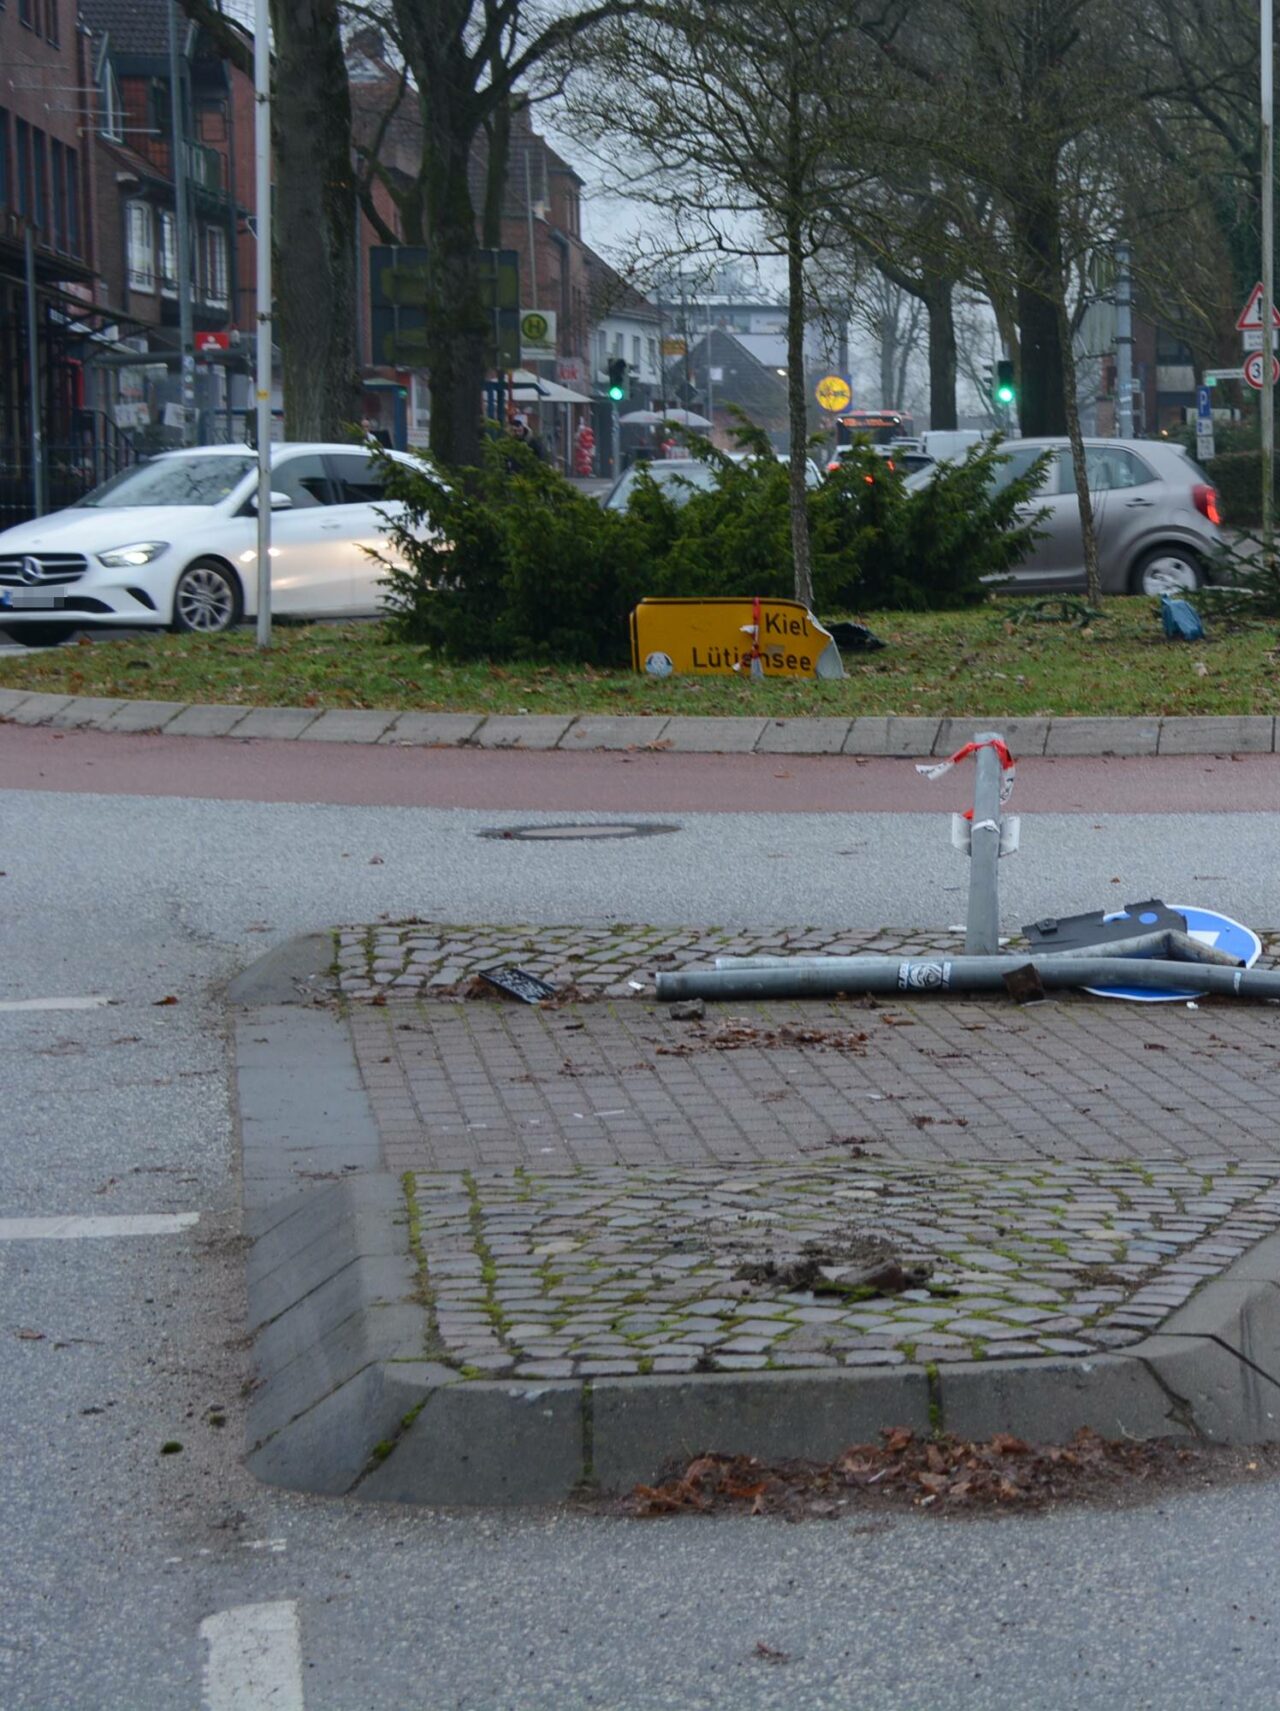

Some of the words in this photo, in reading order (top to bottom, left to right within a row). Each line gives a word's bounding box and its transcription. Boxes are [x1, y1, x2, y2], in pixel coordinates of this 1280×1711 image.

[527, 319, 541, 334] H
[1200, 390, 1208, 414] P
[765, 612, 808, 637] Kiel
